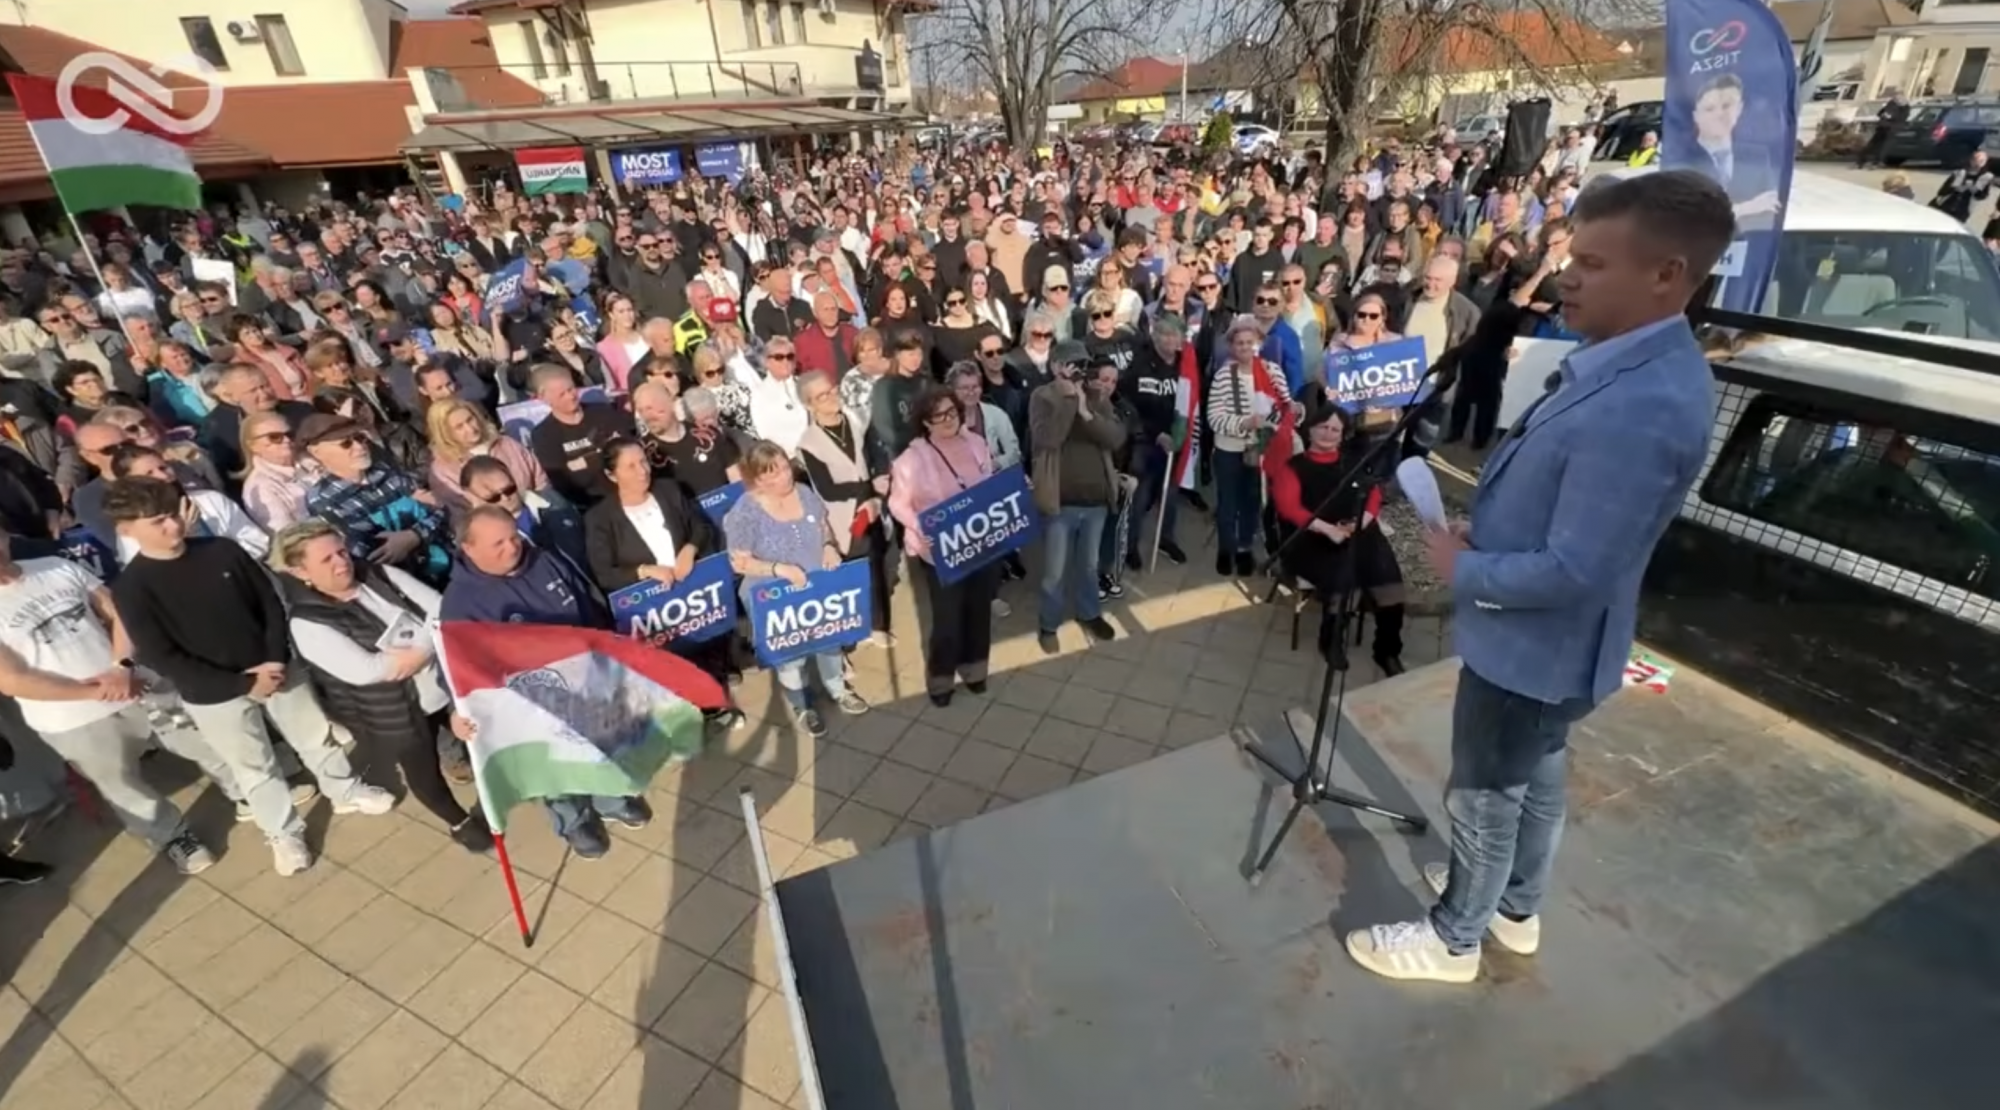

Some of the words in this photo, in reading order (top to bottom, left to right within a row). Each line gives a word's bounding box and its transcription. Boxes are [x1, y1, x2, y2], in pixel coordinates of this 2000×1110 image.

[621, 153, 671, 170] MOST
[1338, 358, 1419, 391] MOST
[701, 493, 728, 509] TISZA
[948, 497, 974, 514] TISZA
[939, 490, 1022, 557] MOST
[944, 540, 982, 569] VAGY
[985, 514, 1031, 547] SOHA!
[630, 581, 724, 642] MOST
[680, 605, 728, 636] SOHA!
[766, 588, 862, 637] MOST
[766, 628, 810, 652] VAGY
[814, 615, 863, 640] SOHA!
